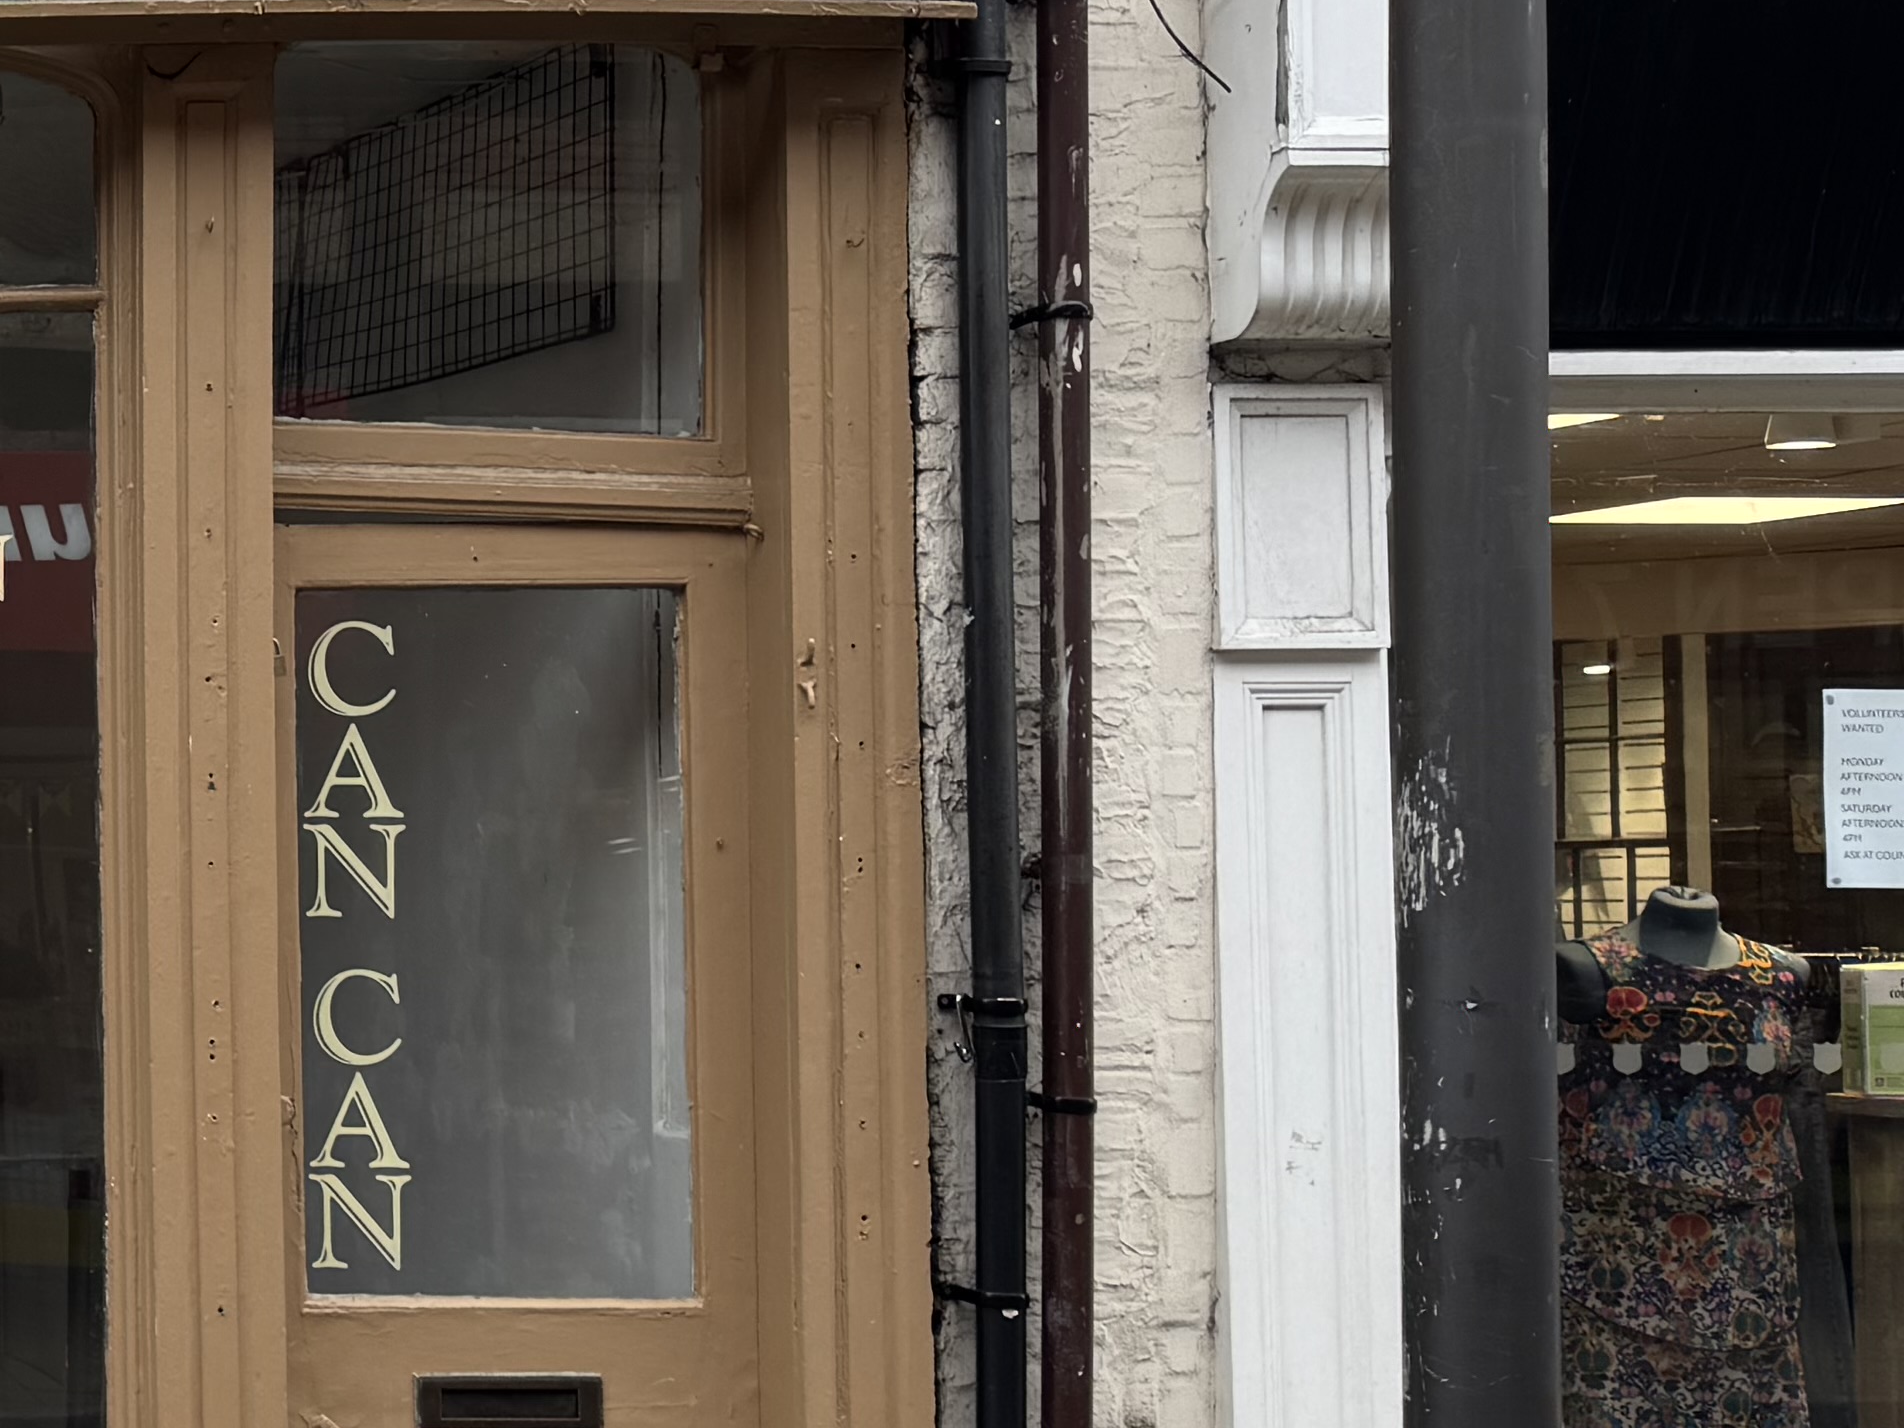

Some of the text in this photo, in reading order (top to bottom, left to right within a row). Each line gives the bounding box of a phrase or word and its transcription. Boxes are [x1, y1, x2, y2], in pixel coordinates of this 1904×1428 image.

[304, 619, 412, 1271] CAN CAN
[1841, 804, 1892, 813] SATURDAY
